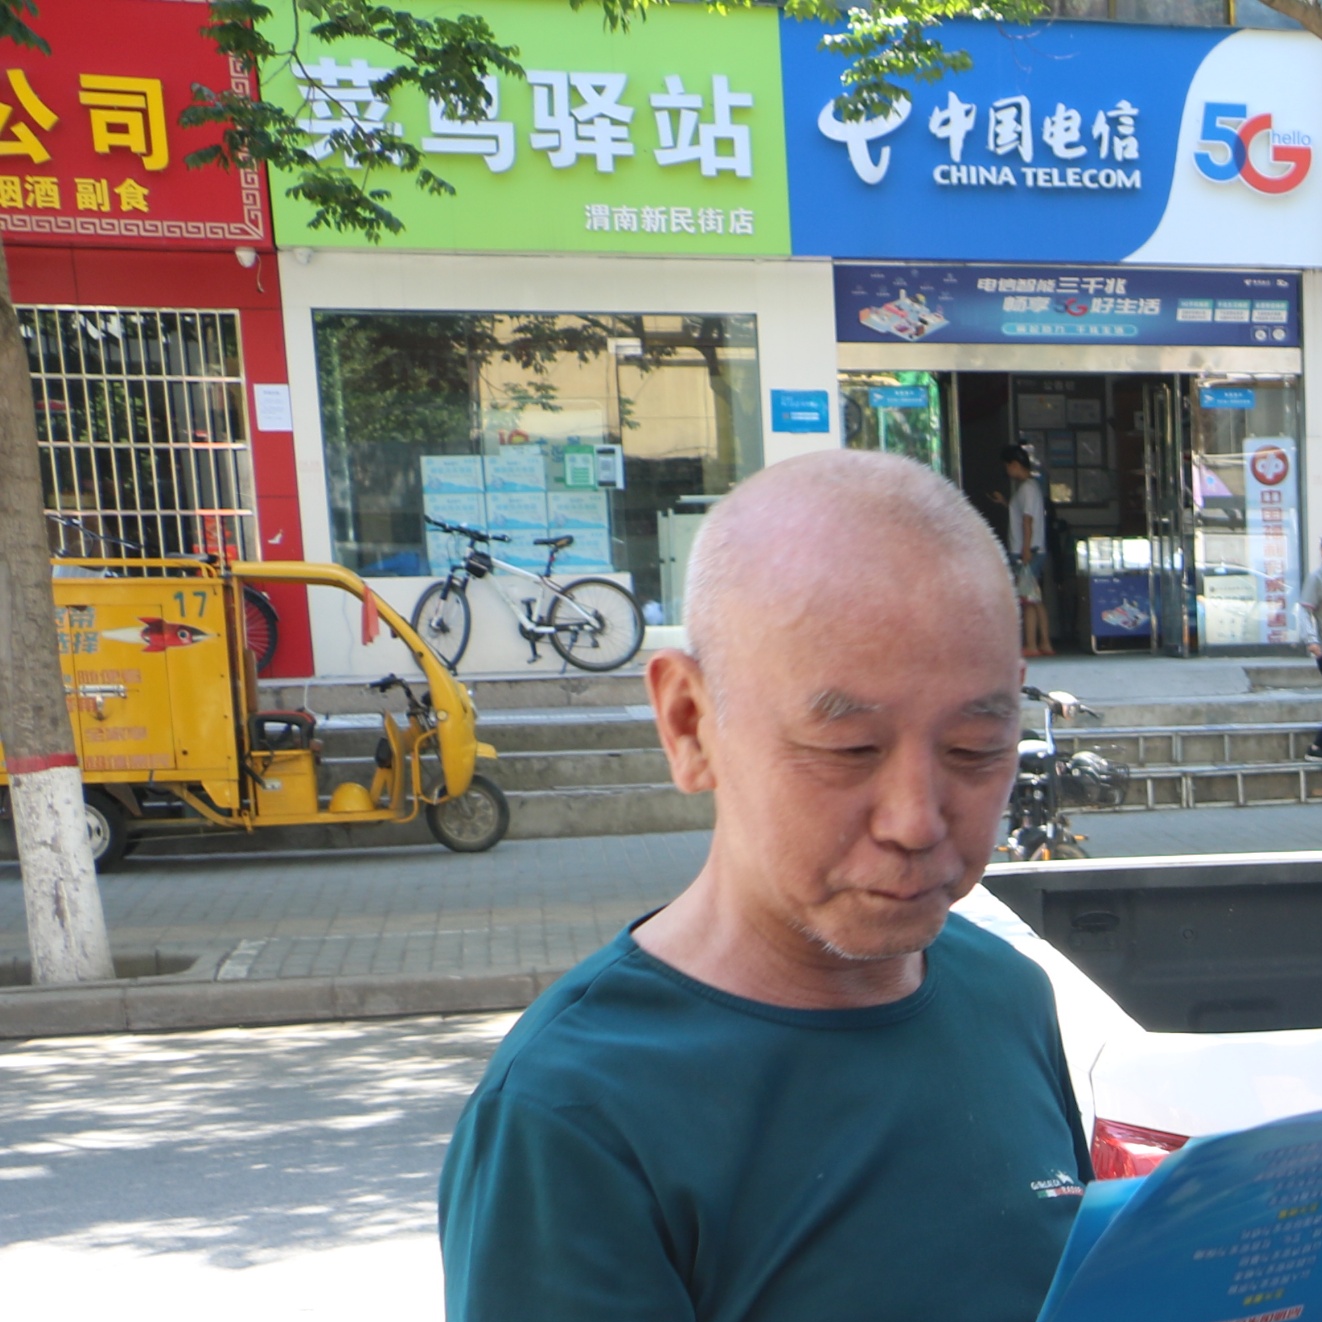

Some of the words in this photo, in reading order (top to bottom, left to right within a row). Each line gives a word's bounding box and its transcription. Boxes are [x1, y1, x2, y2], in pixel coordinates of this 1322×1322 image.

[0, 68, 169, 172] 公司
[291, 56, 754, 178] 菜鸟驿站
[928, 91, 1140, 163] 中国电信
[1193, 101, 1313, 195] 5G
[1271, 129, 1312, 148] hello
[932, 163, 1017, 188] CHINA
[1020, 165, 1142, 190] TELECOM
[74, 177, 150, 213] 副食
[585, 204, 755, 236] 渭南新民街店
[172, 590, 208, 619] 17
